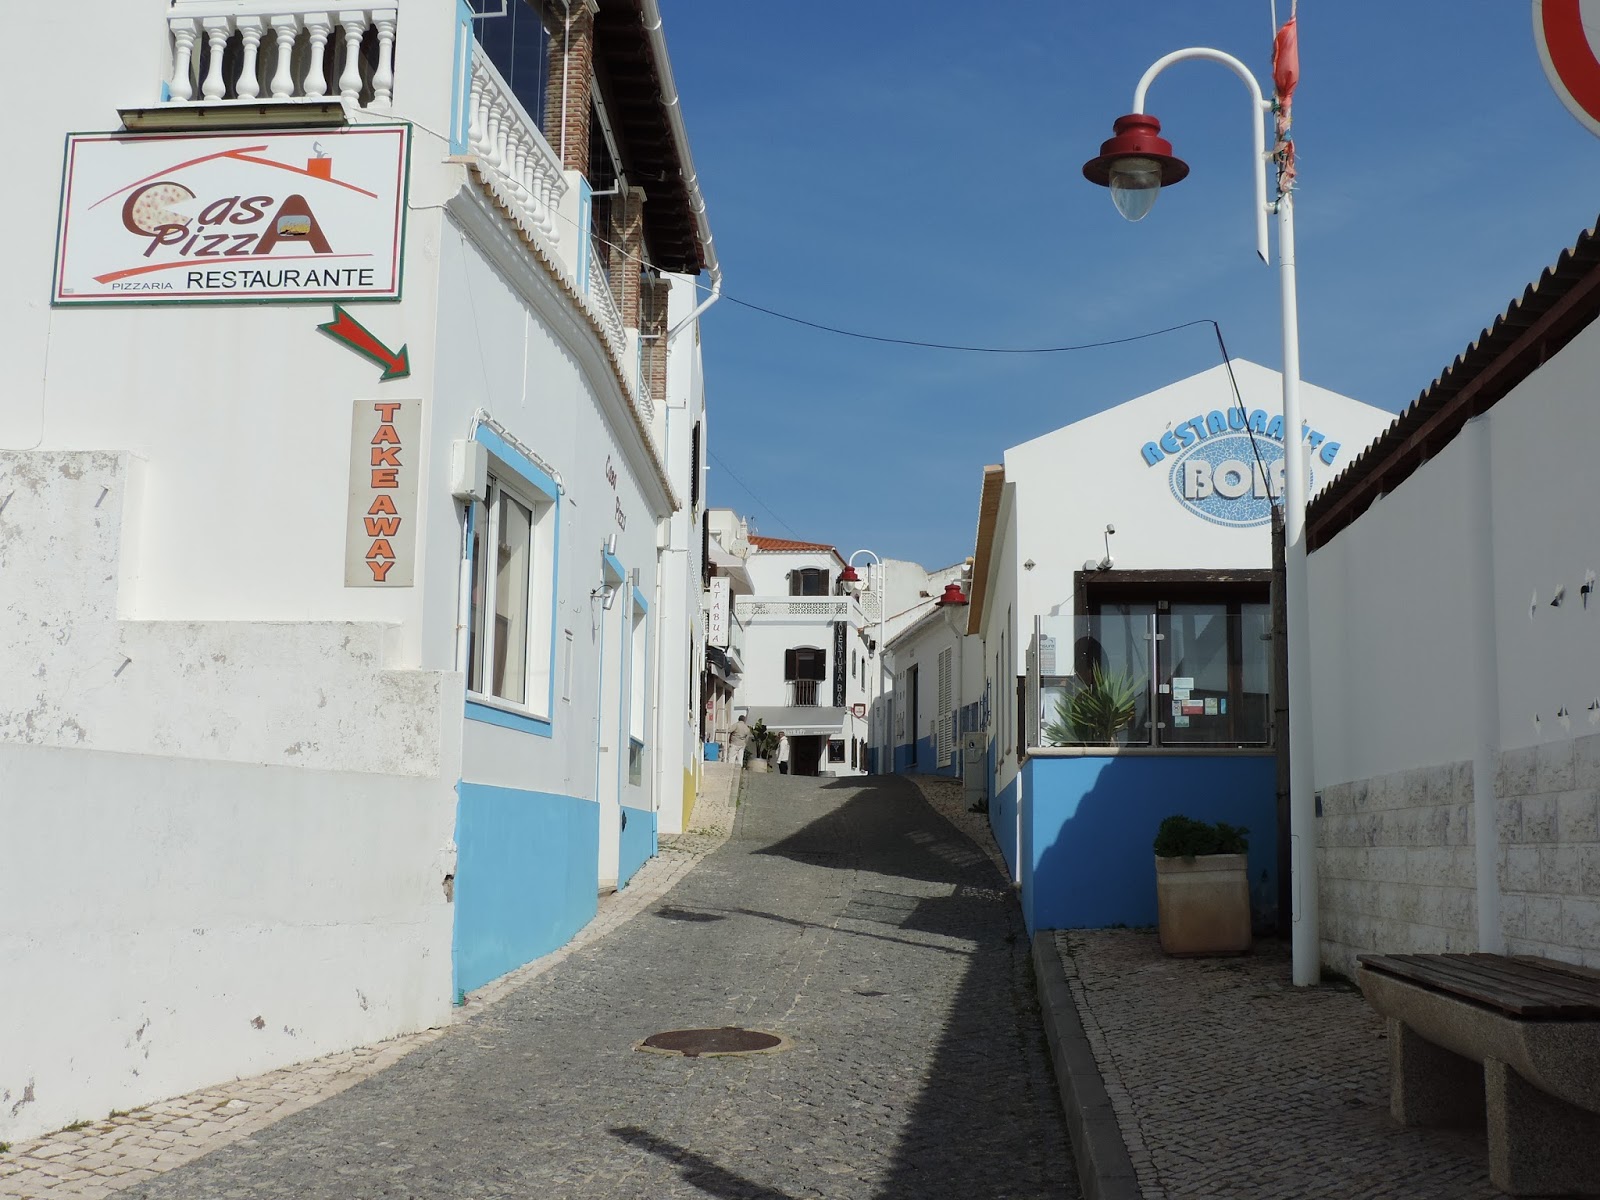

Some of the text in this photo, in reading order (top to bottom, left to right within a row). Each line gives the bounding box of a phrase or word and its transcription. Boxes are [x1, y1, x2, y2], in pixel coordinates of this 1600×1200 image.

[112, 268, 375, 291] PIZZARIA RESTAURANTE
[363, 402, 403, 582] TAKE AWAY
